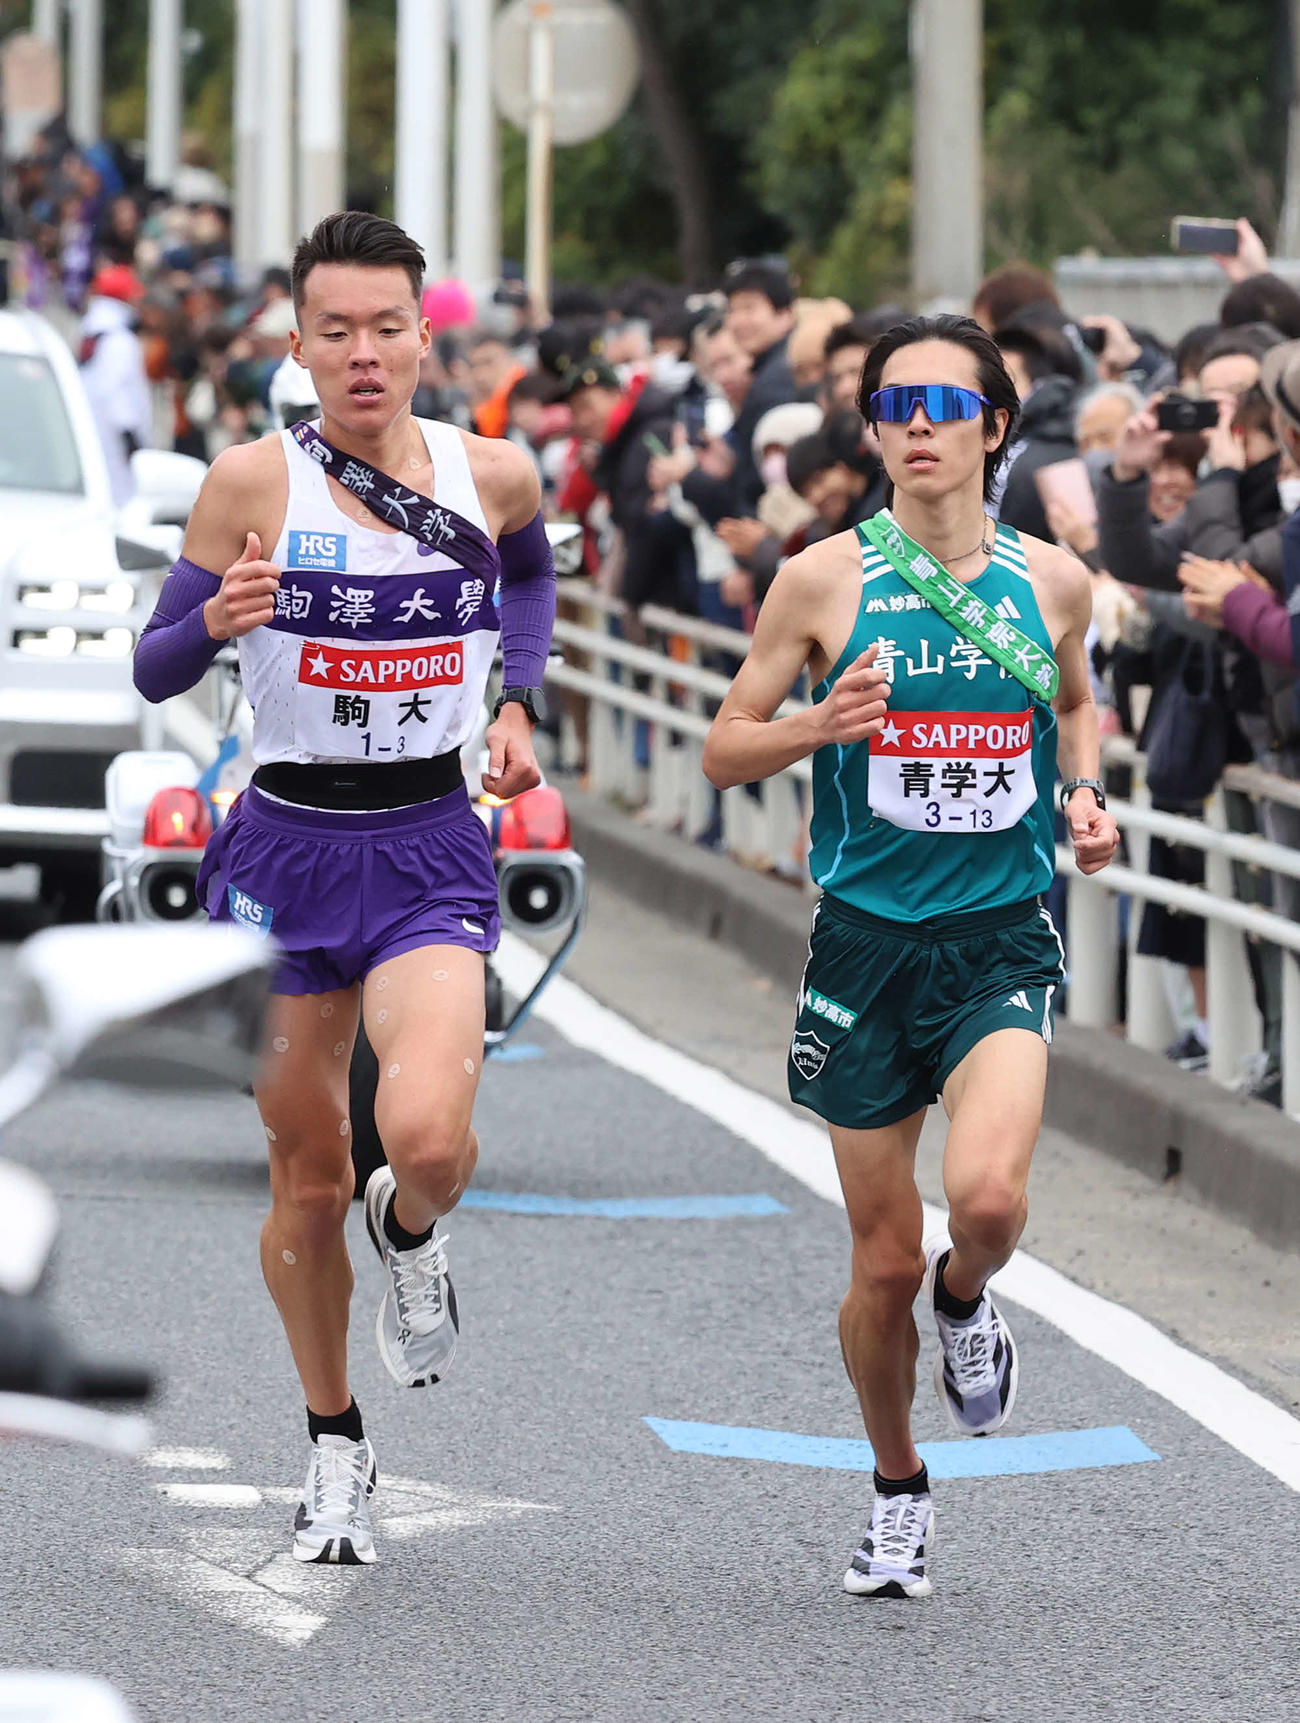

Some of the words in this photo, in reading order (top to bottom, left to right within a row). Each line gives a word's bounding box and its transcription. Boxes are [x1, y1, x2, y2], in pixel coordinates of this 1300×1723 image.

[298, 534, 337, 557] HRS
[274, 578, 486, 629] 駒澤大學
[339, 652, 462, 684] SAPPORO
[869, 635, 1013, 685] 青山学
[332, 693, 432, 729] 駒大
[360, 732, 406, 757] 1-3
[911, 721, 1029, 750] SAPPORO
[898, 761, 1016, 799] 青学大
[924, 801, 993, 829] 3-13
[234, 891, 264, 923] HRS
